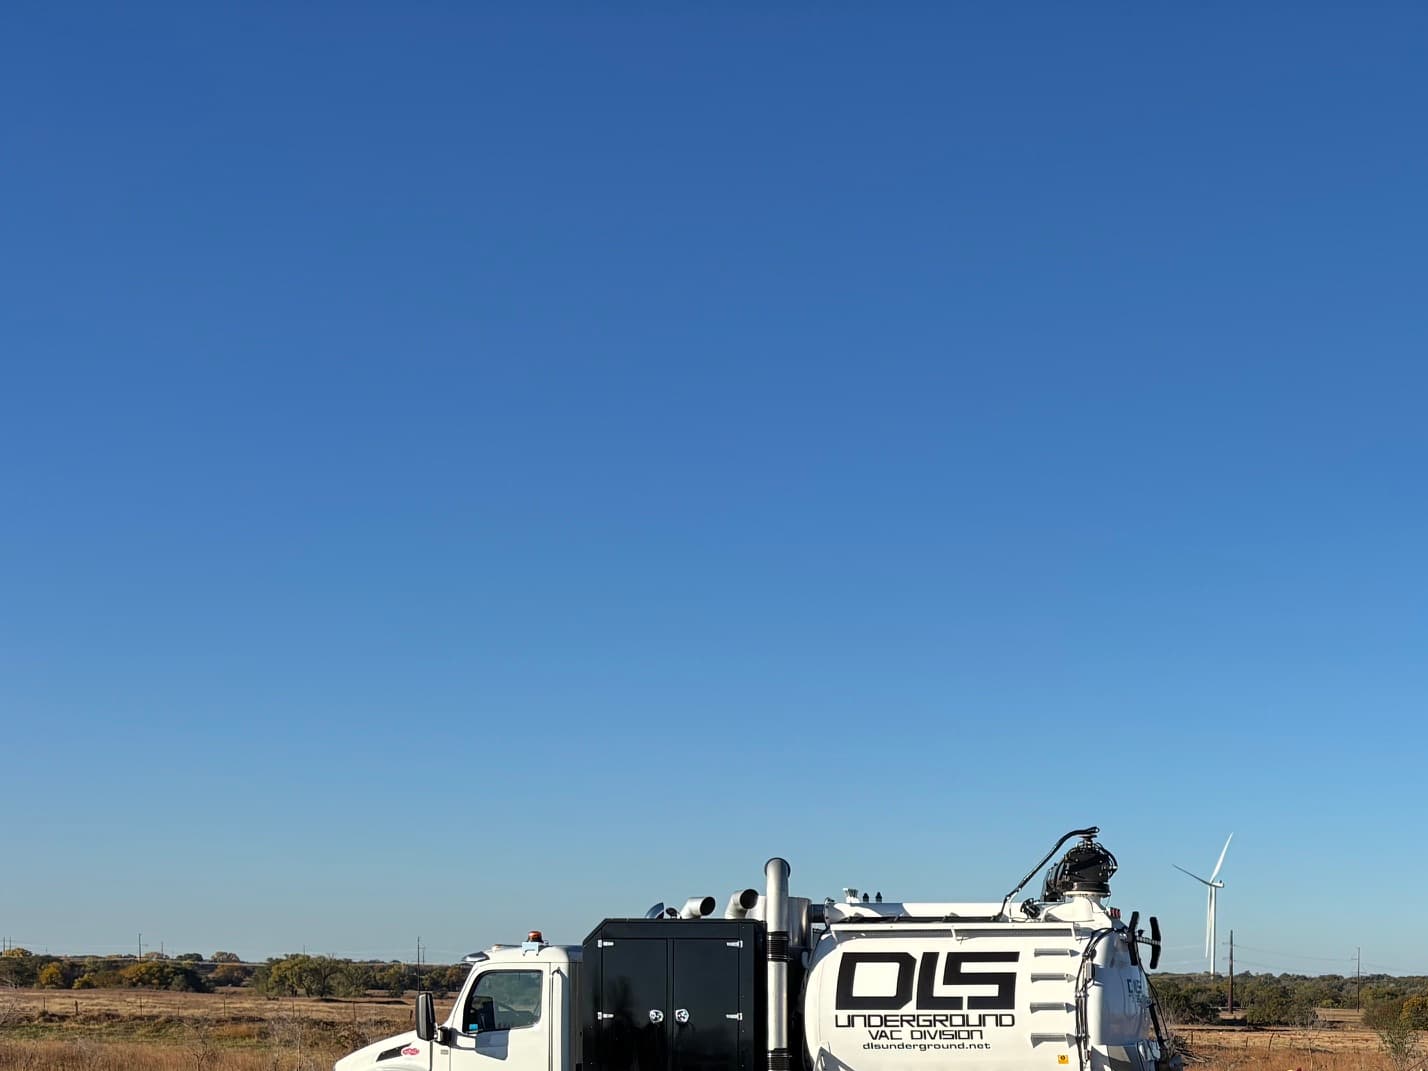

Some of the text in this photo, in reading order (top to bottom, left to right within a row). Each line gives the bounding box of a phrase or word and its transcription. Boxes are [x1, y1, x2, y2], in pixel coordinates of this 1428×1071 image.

[835, 951, 1020, 1010] DLS
[835, 1013, 1015, 1028] UNDERGROUND
[868, 1029, 983, 1040] VAC DIVISION
[862, 1042, 991, 1051] dlsunderground.net
